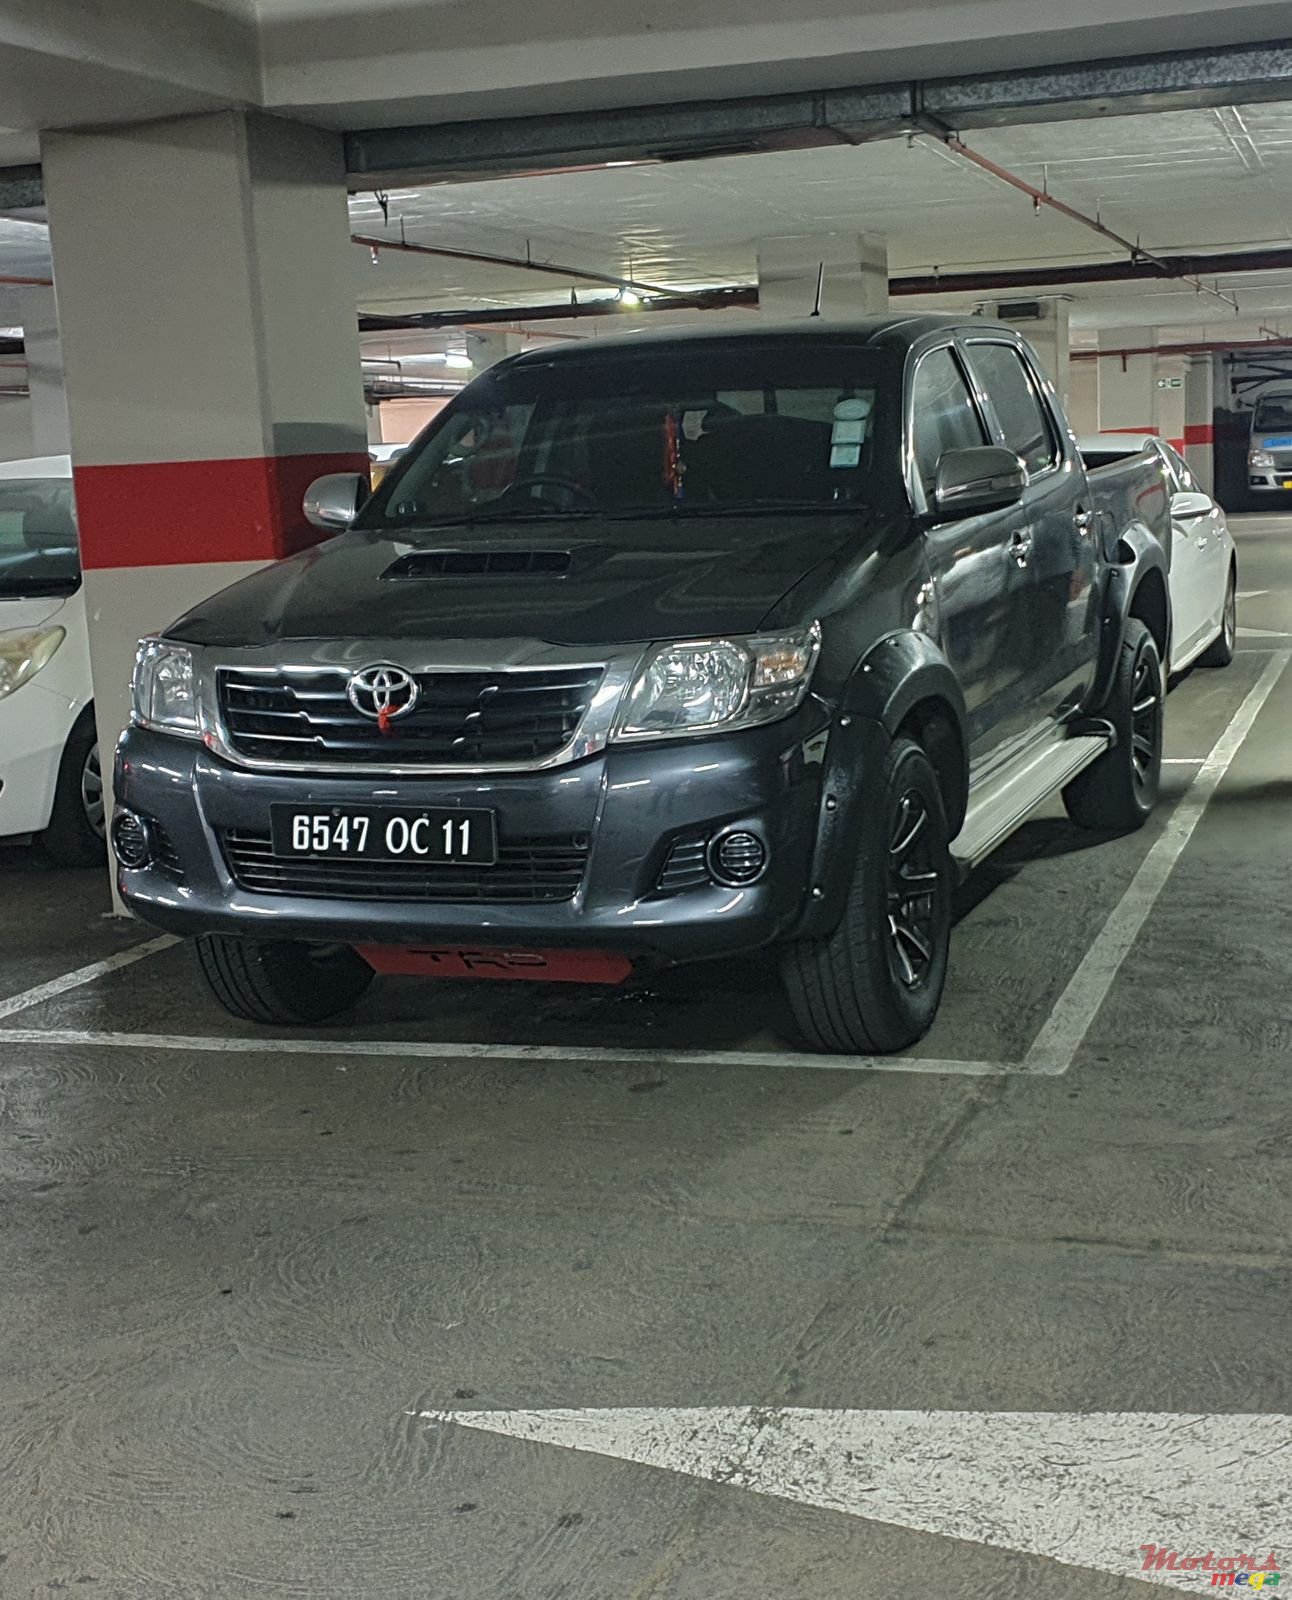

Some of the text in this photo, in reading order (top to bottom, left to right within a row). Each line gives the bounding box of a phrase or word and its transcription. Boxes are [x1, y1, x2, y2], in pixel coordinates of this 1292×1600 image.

[292, 815, 470, 855] 6547 OC 11
